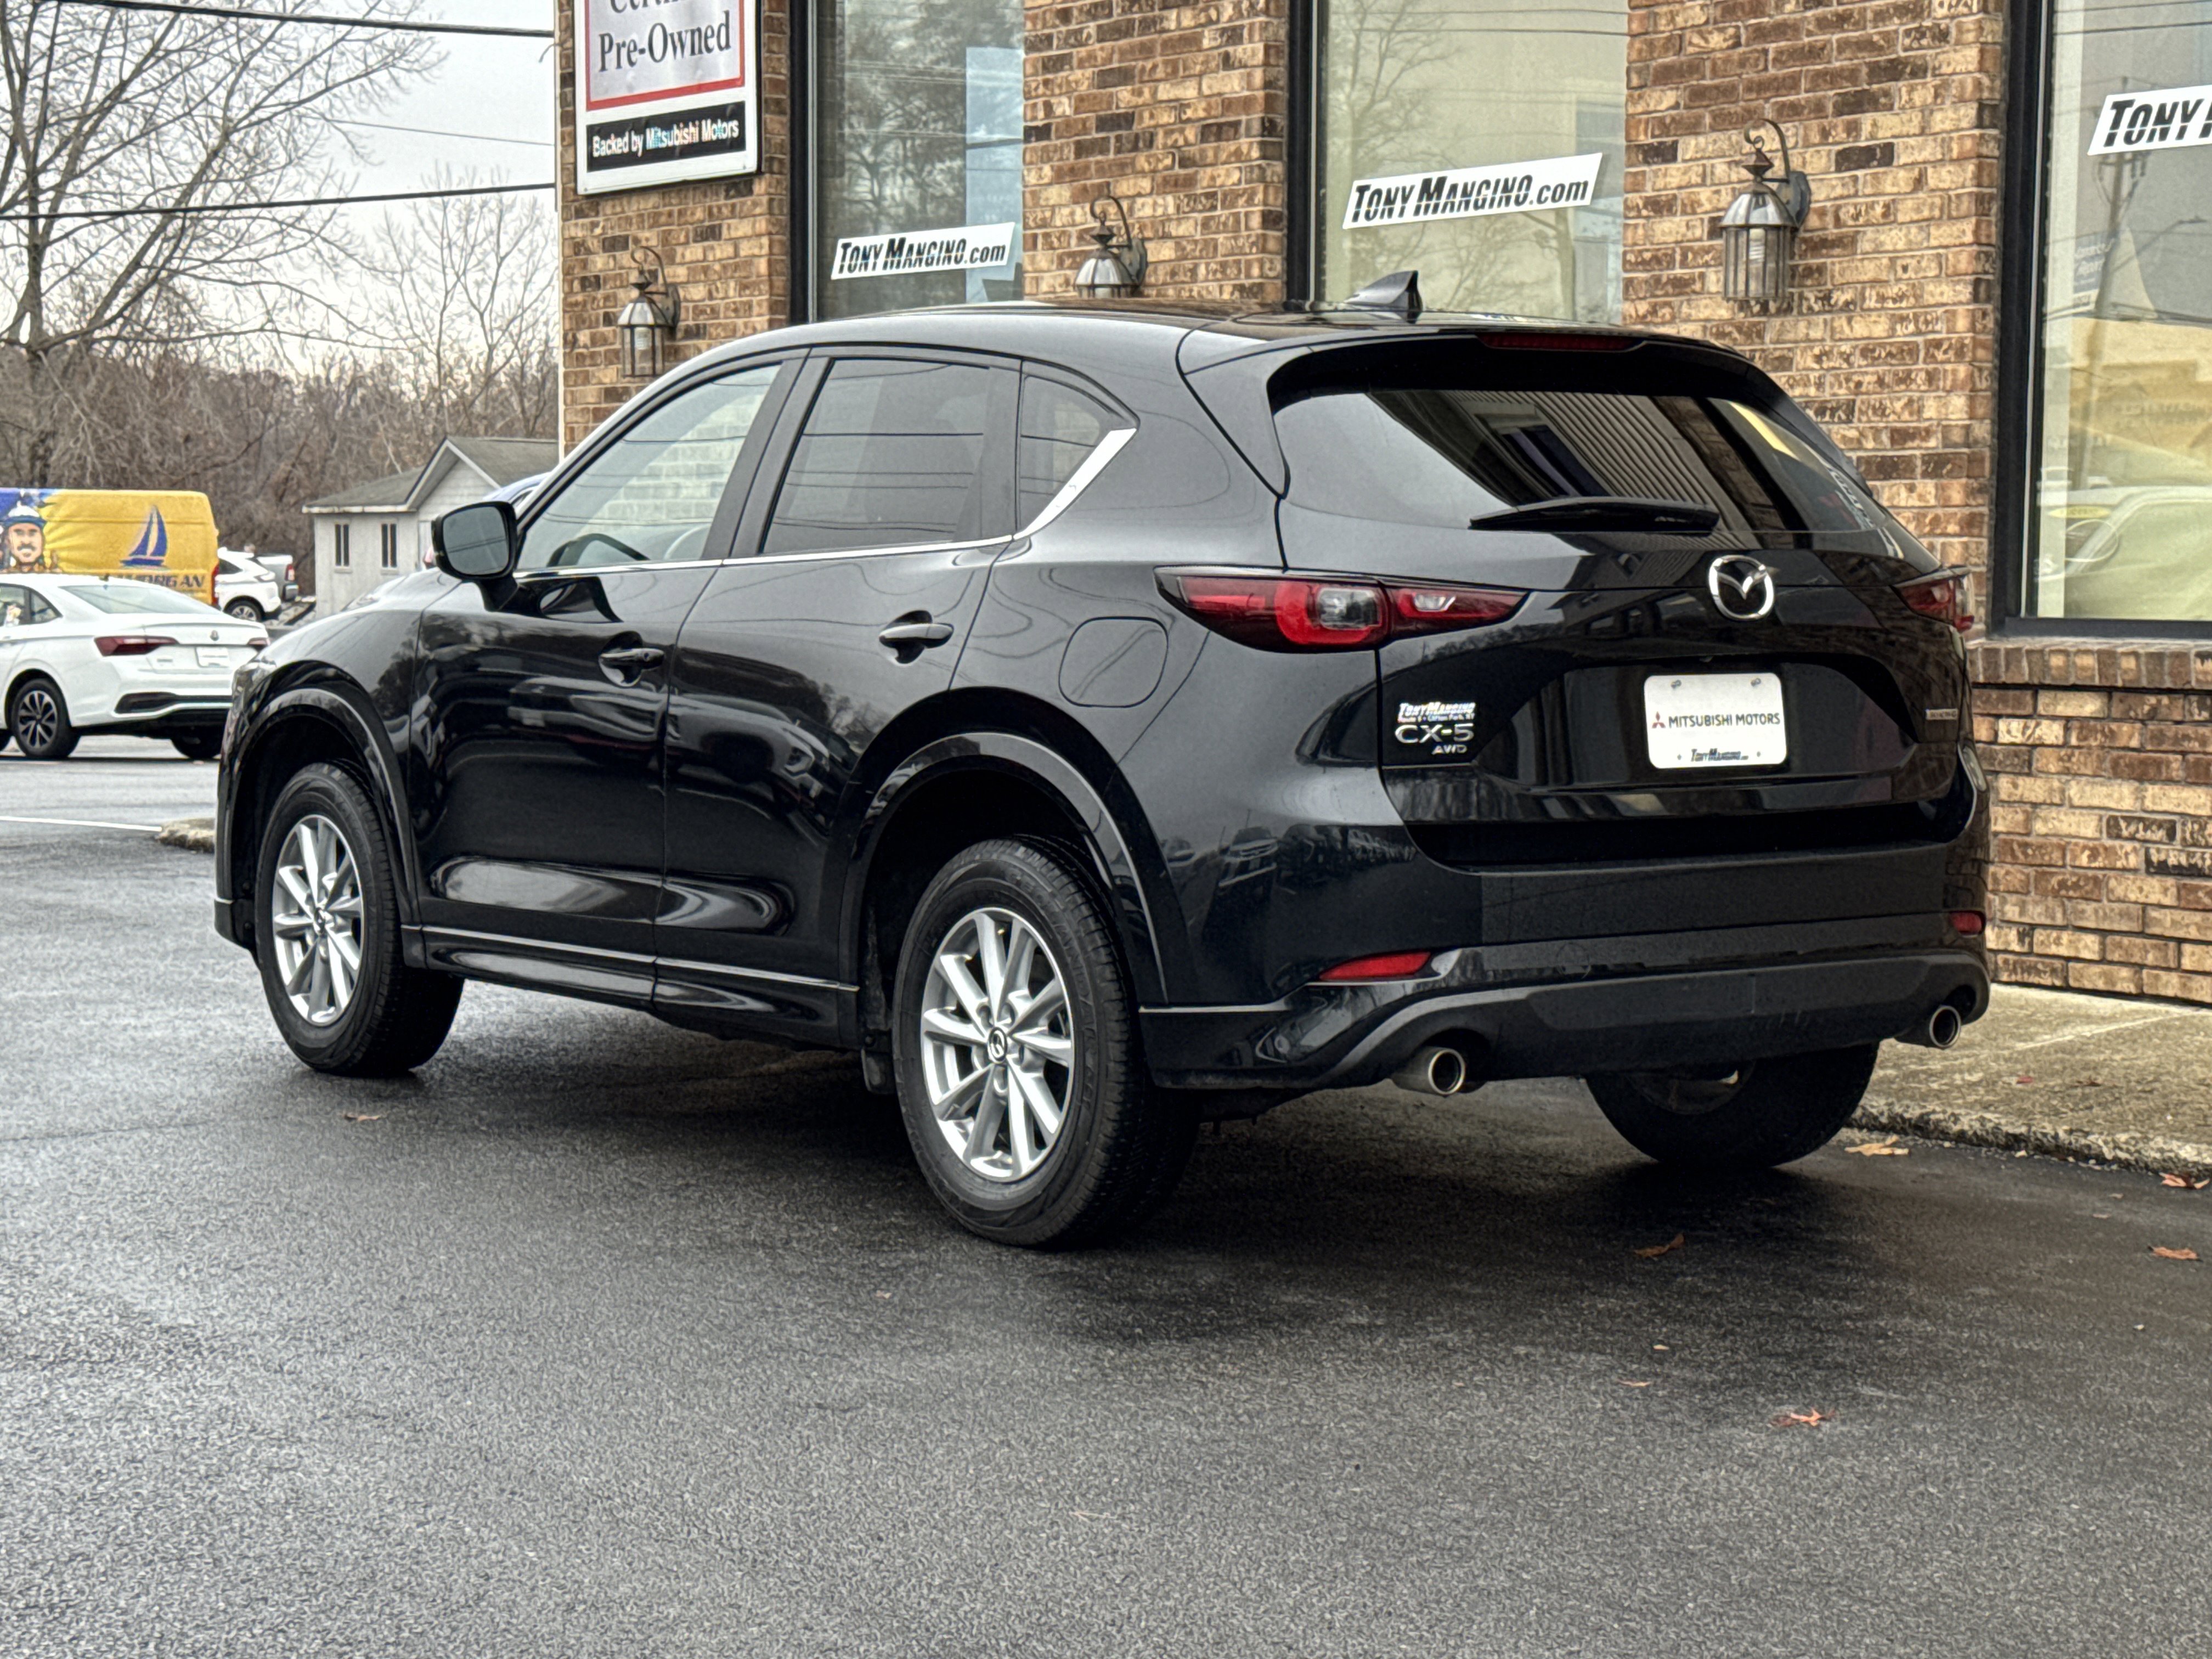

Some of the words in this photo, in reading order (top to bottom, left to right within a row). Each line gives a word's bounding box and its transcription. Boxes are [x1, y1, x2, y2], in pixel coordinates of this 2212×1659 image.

[598, 10, 731, 72] Pre-Owned
[592, 131, 629, 157] Backed
[631, 129, 644, 157] by
[645, 120, 699, 150] Mitsubishi
[701, 119, 740, 142] Motors
[2103, 98, 2204, 148] TONY
[1395, 723, 1475, 743] CX-5
[1668, 714, 1733, 729] MITSUBISHI
[1735, 713, 1781, 726] MOTORS
